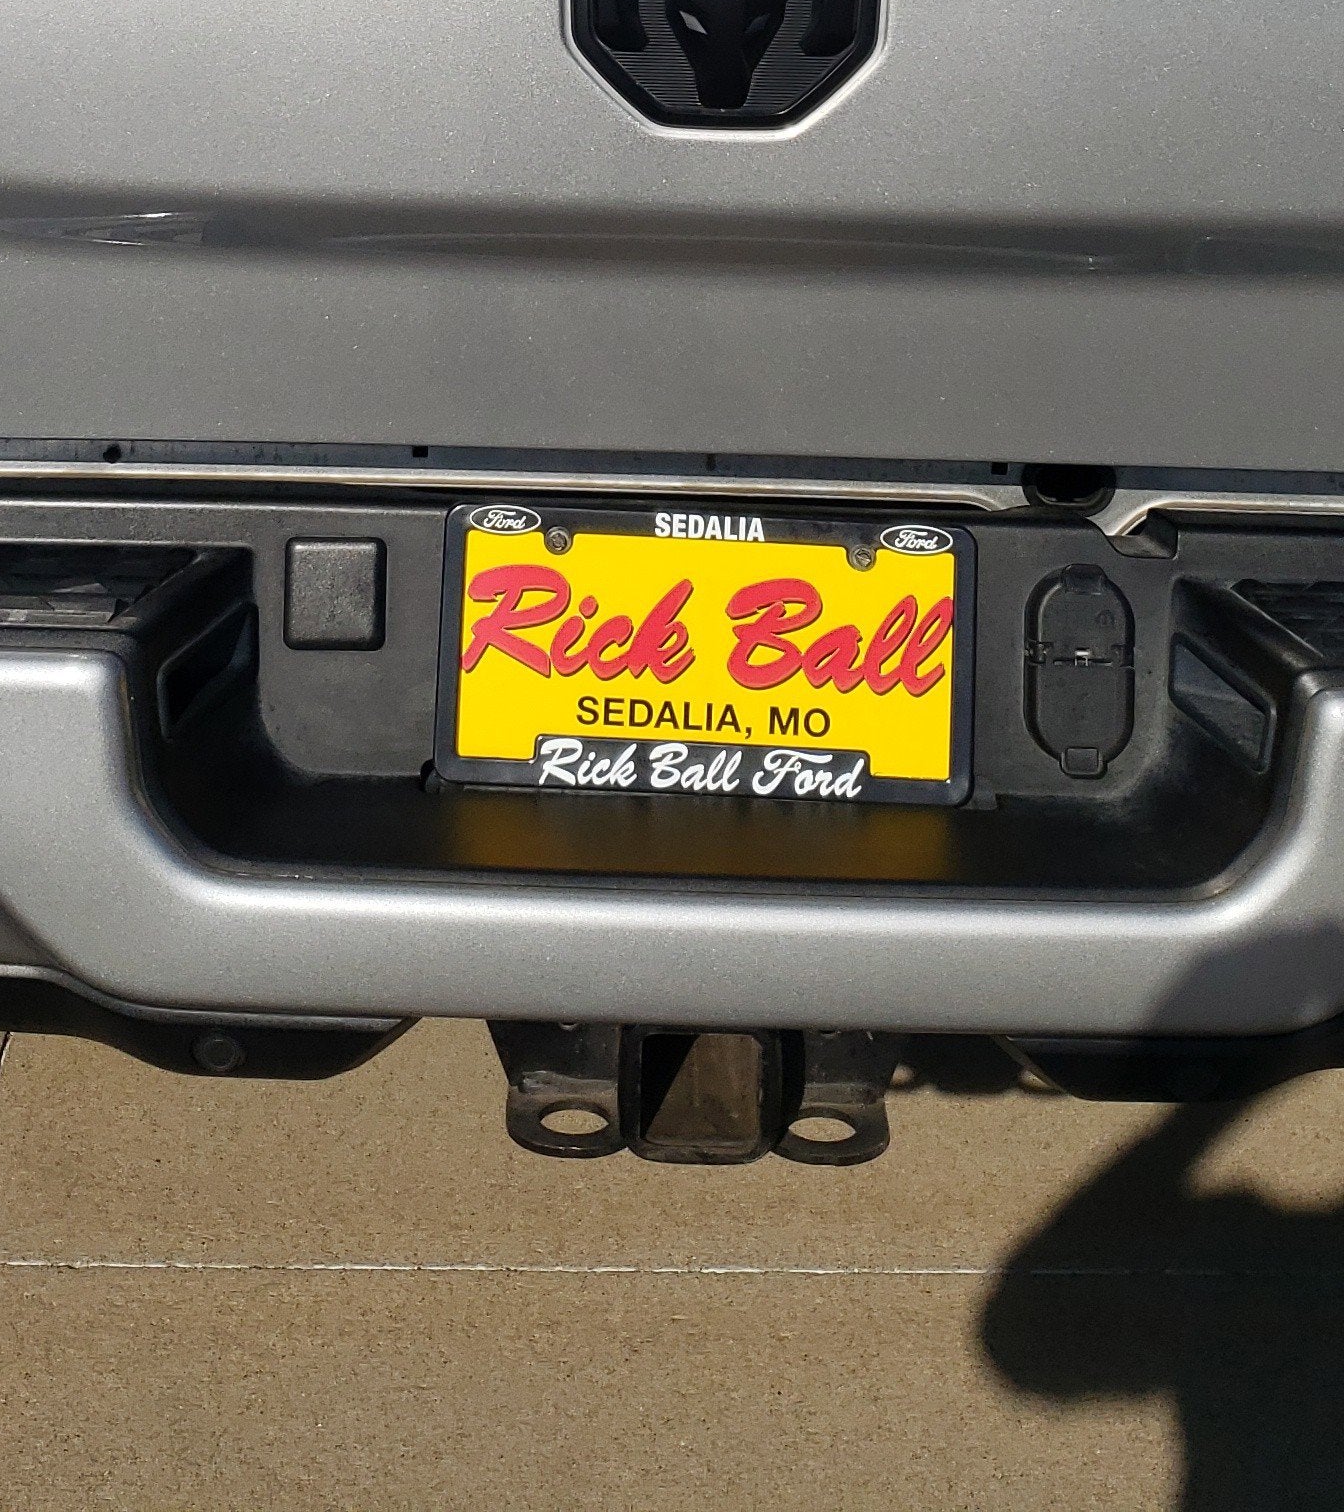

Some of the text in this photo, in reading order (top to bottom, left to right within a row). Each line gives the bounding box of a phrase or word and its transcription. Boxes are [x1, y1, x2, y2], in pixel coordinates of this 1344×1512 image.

[481, 508, 529, 530] Ford
[654, 512, 765, 543] SEDALIA
[893, 529, 939, 551] Ford
[461, 564, 954, 697] Rick Ball
[576, 695, 832, 740] SEDALIA, MO
[539, 737, 864, 799] Rick Ball Ford
